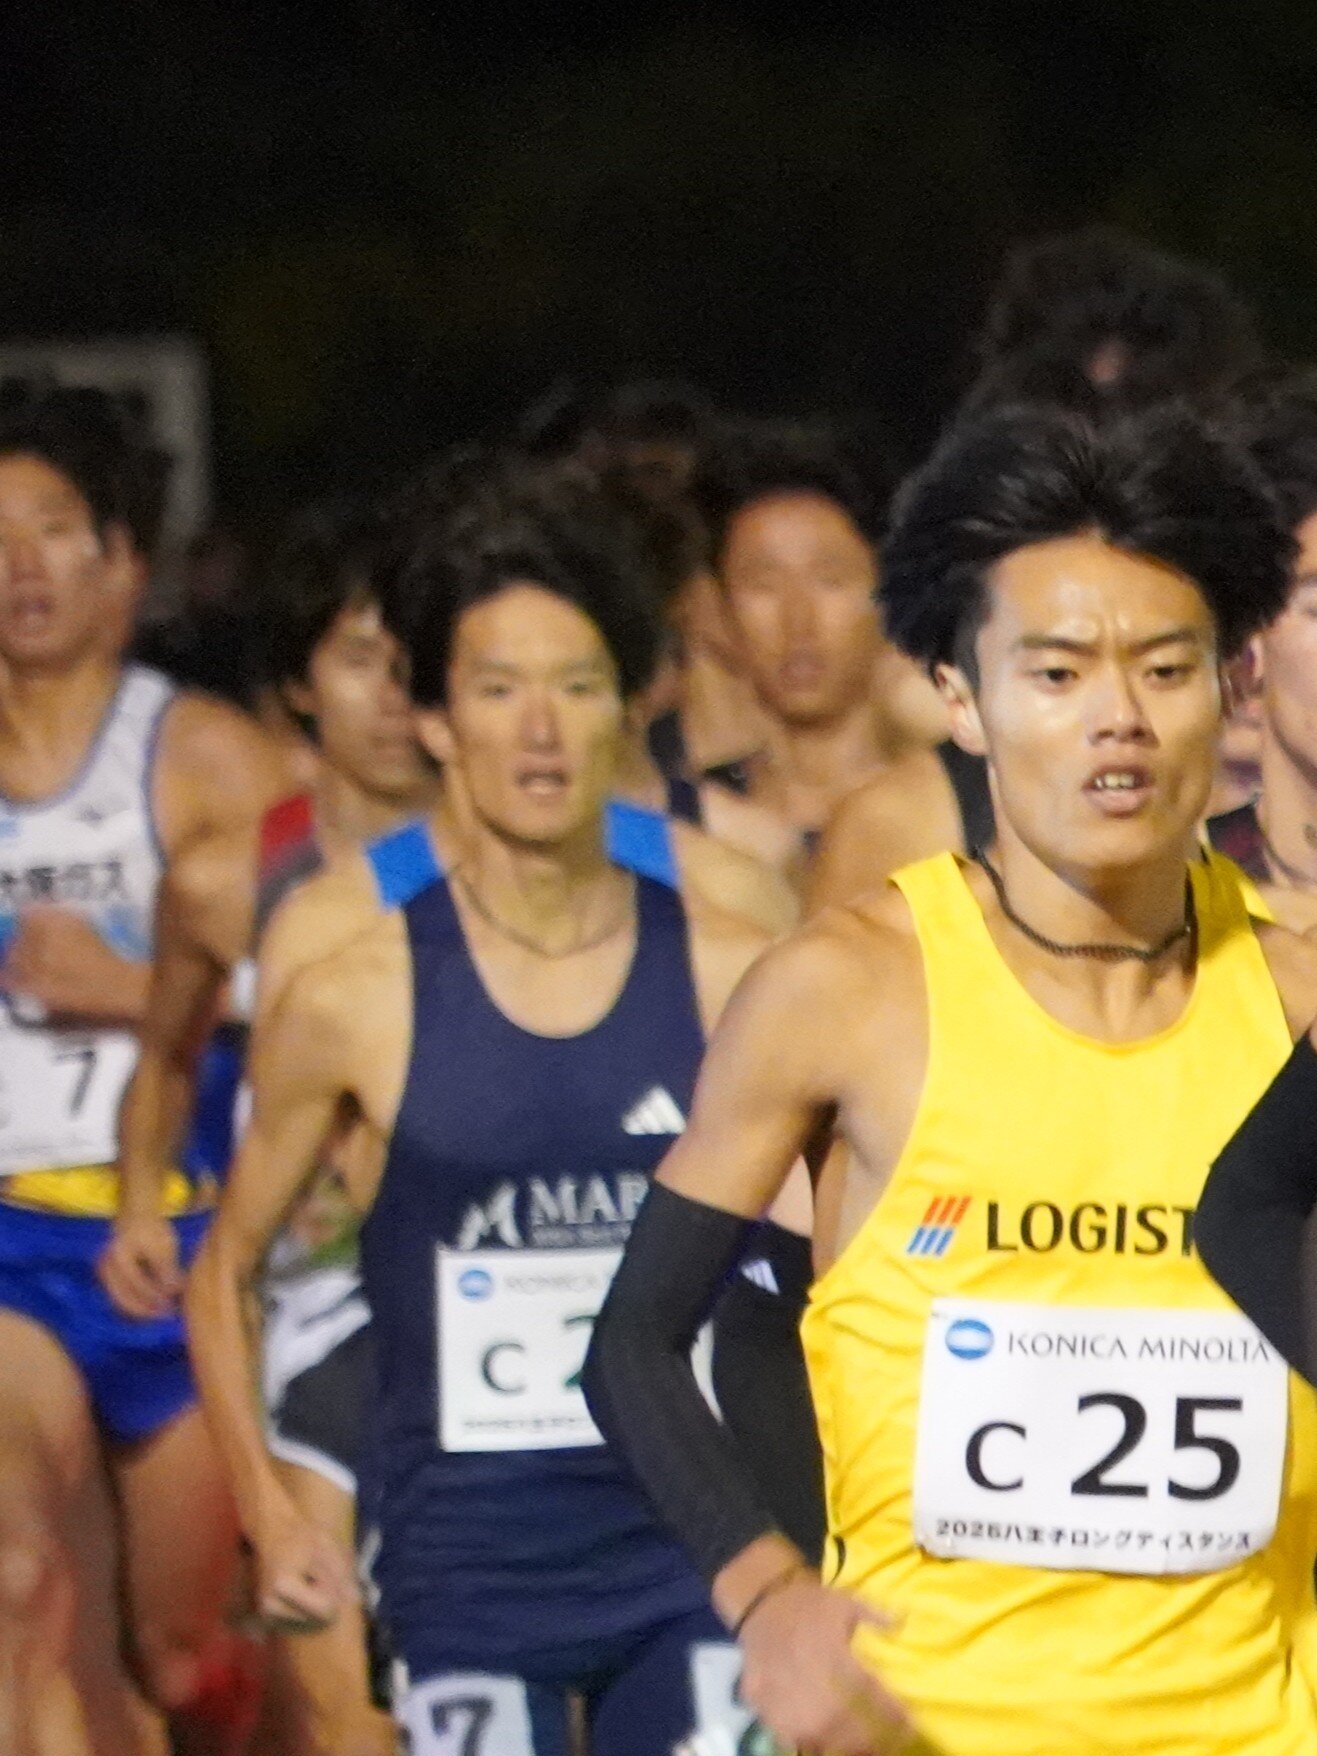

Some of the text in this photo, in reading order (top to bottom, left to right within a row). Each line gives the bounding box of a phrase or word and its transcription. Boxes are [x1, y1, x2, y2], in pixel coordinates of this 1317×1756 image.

[1007, 1331, 1270, 1363] KONICA MINOLTA
[965, 1393, 1243, 1501] C 25
